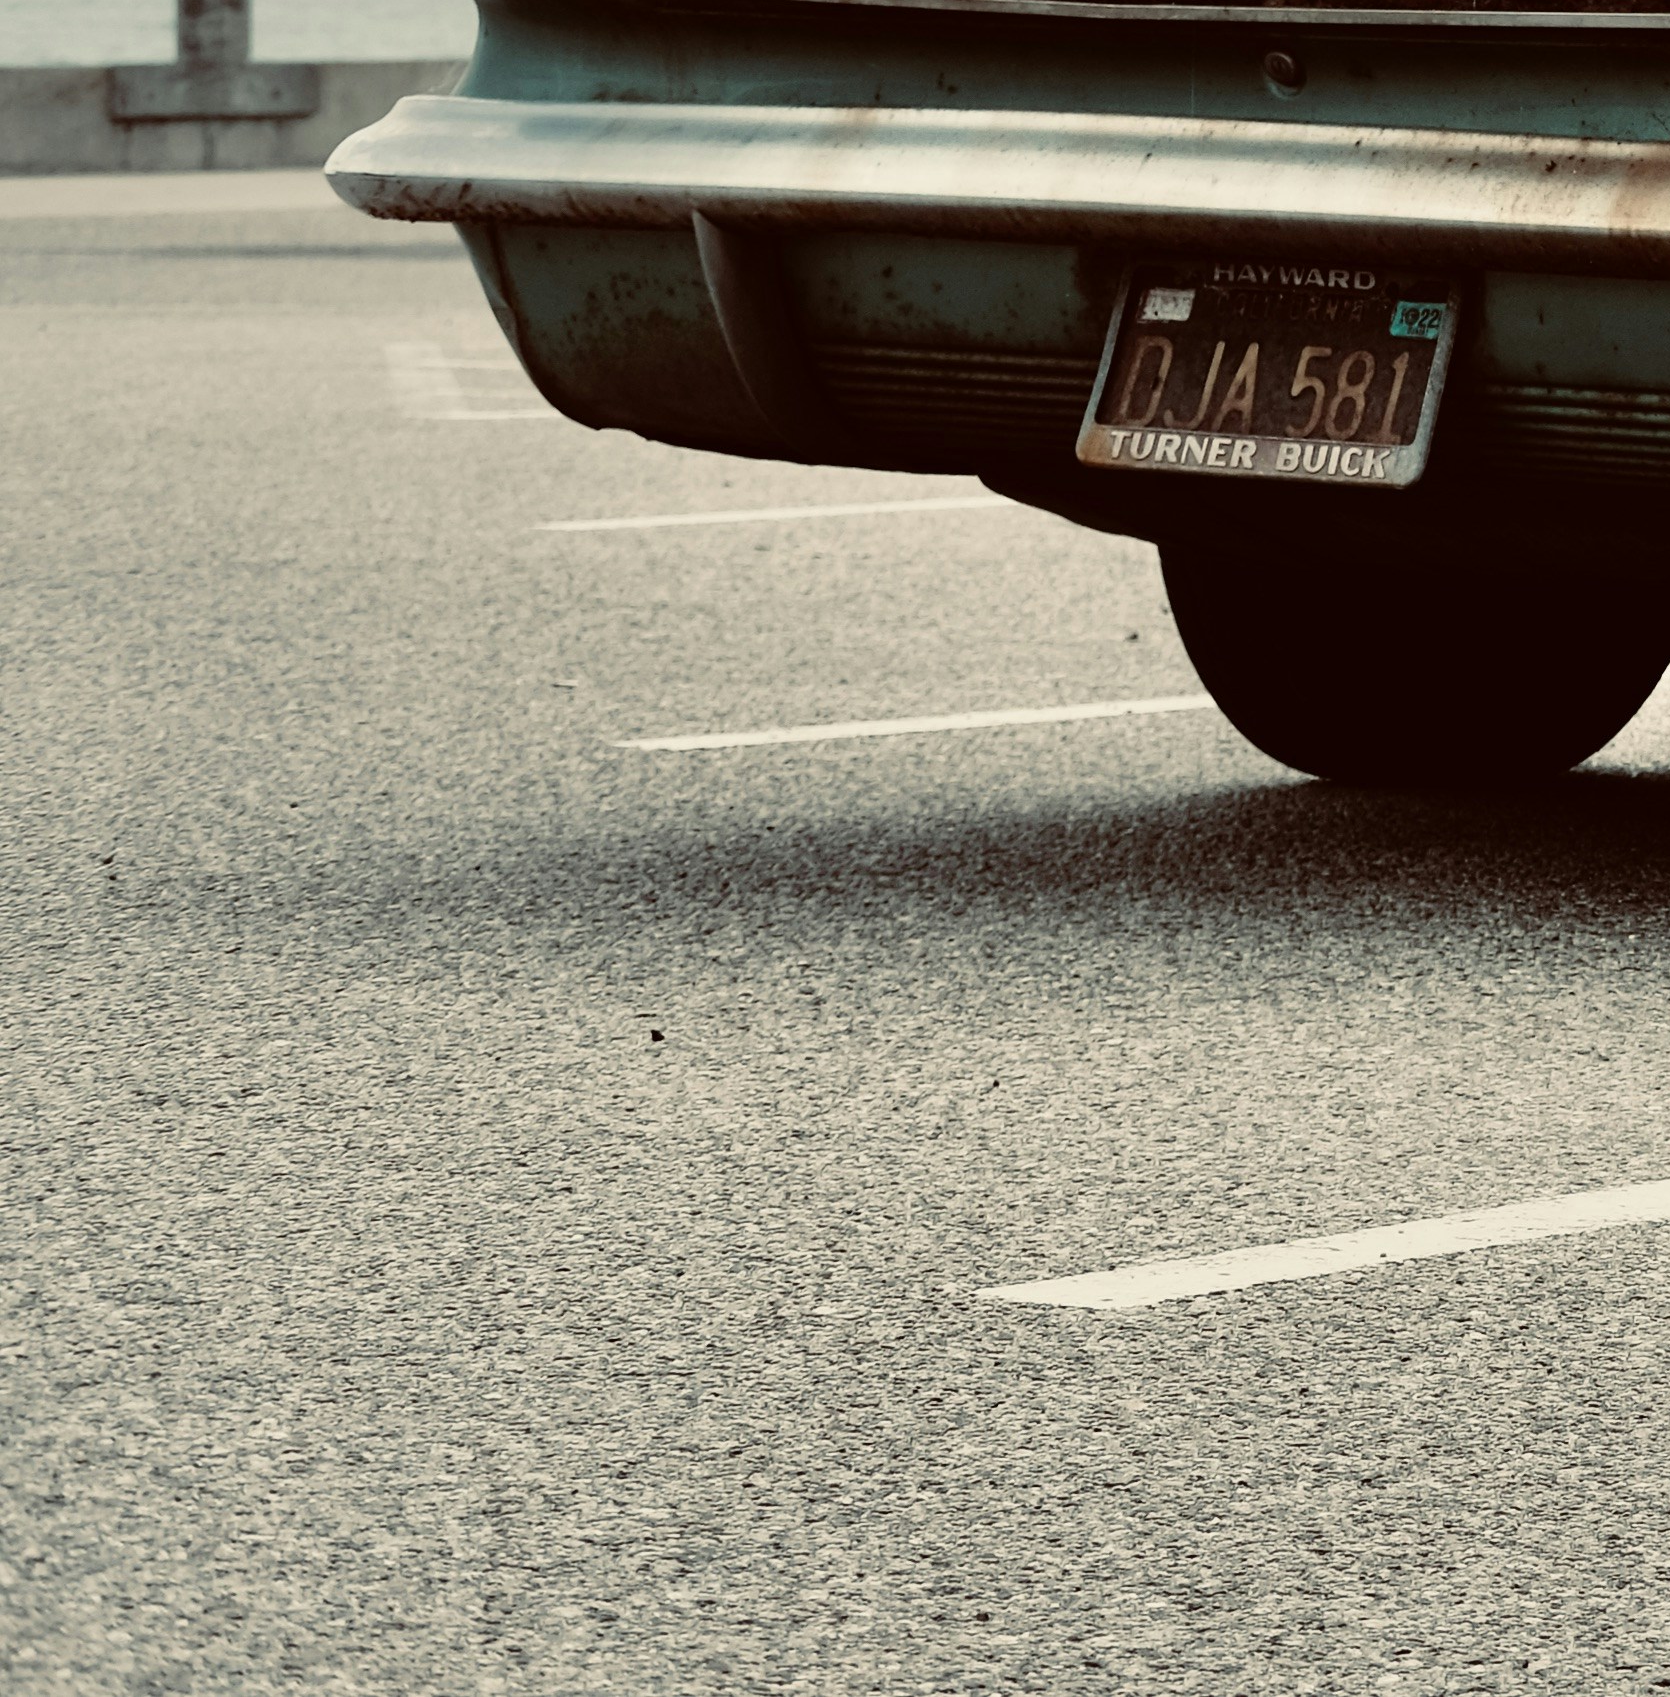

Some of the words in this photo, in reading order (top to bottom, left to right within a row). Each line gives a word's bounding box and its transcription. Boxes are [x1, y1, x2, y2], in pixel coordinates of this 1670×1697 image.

[1213, 262, 1377, 291] HAYWARD
[1216, 292, 1365, 323] CALIORNIA
[1114, 335, 1260, 434] DJA
[1285, 345, 1410, 441] 581
[1109, 429, 1258, 470] TURNER
[1275, 440, 1392, 480] BUICK
